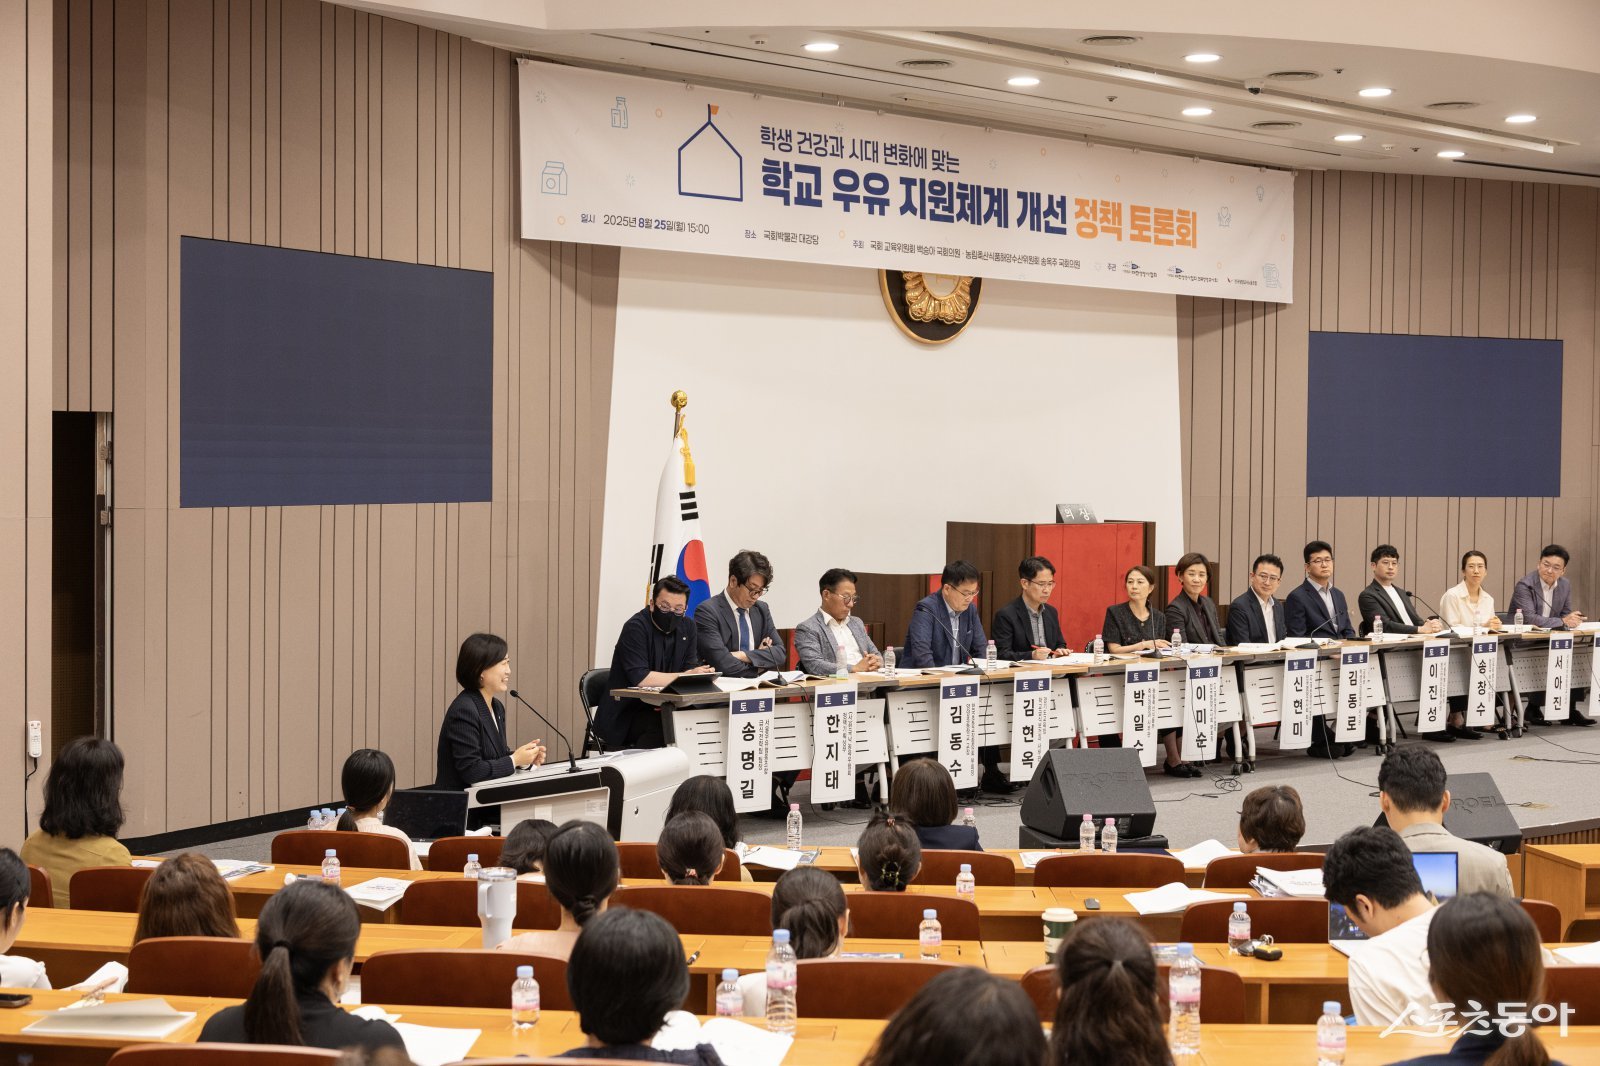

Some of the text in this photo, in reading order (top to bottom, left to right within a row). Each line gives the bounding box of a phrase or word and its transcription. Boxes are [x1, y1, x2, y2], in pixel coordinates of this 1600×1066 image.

[760, 125, 960, 174] 학생 건강과 시대 변화에 맞는
[580, 213, 710, 235] 일시 2025년 8월 25일(월) 15:00
[761, 157, 1198, 248] 학교 우유 지원체계 개선 정책 토론회
[744, 229, 819, 245] 장소 국회박물관 대강당
[852, 240, 865, 249] 주최
[870, 240, 883, 250] 국회
[884, 241, 916, 254] 교육위원회
[936, 246, 961, 258] 국회의원
[1058, 259, 1081, 270] 국회의원
[1293, 676, 1303, 737] 신현미
[1346, 670, 1358, 731] 김동로
[1427, 663, 1438, 722] 이진성
[1476, 659, 1487, 717] 송창수
[1553, 655, 1563, 711] 서아진
[949, 705, 963, 778] 김동수
[1021, 698, 1035, 769] 김현옥
[1196, 684, 1208, 749] 이미순
[739, 721, 757, 800] 송명길
[825, 713, 840, 790] 한지태
